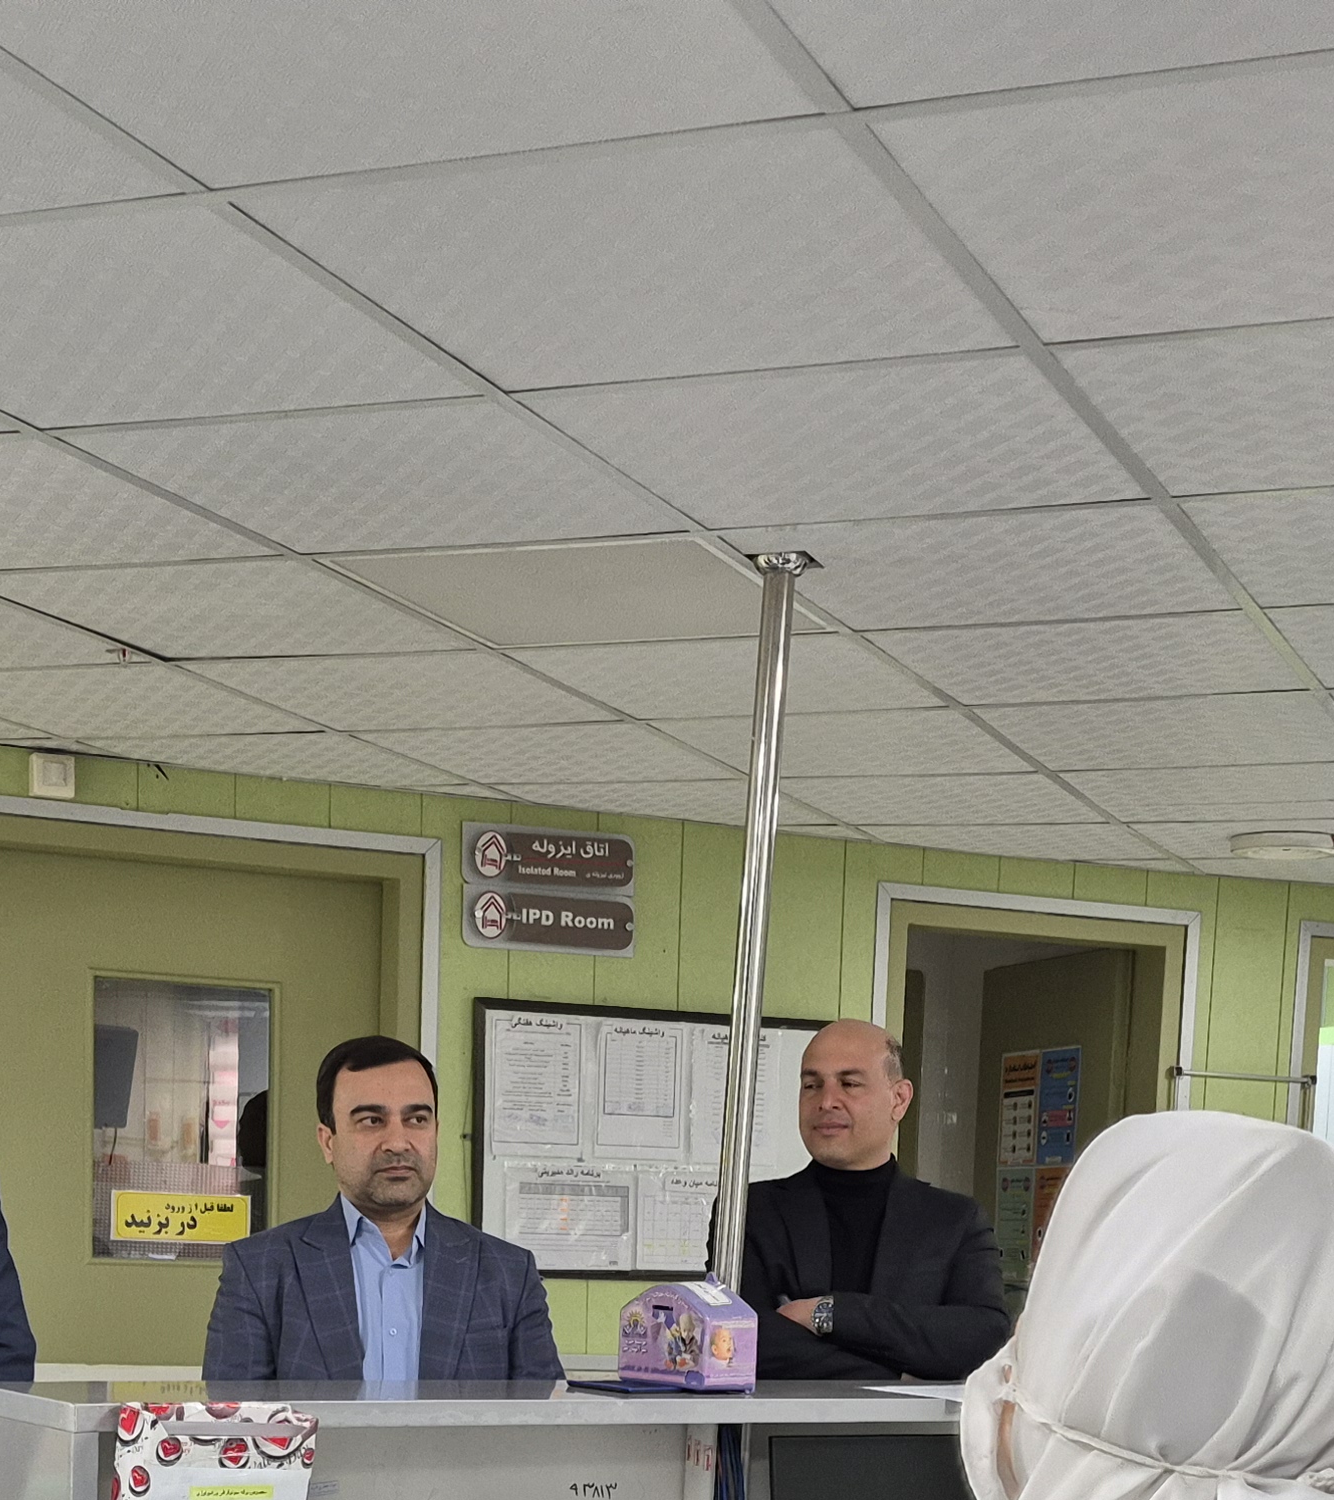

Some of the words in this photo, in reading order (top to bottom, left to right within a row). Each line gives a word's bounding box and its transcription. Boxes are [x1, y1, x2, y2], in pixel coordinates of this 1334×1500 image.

[531, 838, 576, 858] ایزوله
[580, 841, 609, 858] اتاق
[518, 865, 552, 876] Isolated
[553, 866, 577, 877] Room
[521, 908, 555, 926] IPD
[560, 910, 615, 930] Room
[164, 1202, 186, 1214] ورود
[199, 1201, 215, 1215] قبل
[124, 1209, 170, 1235] بزنید
[175, 1215, 198, 1236] در
